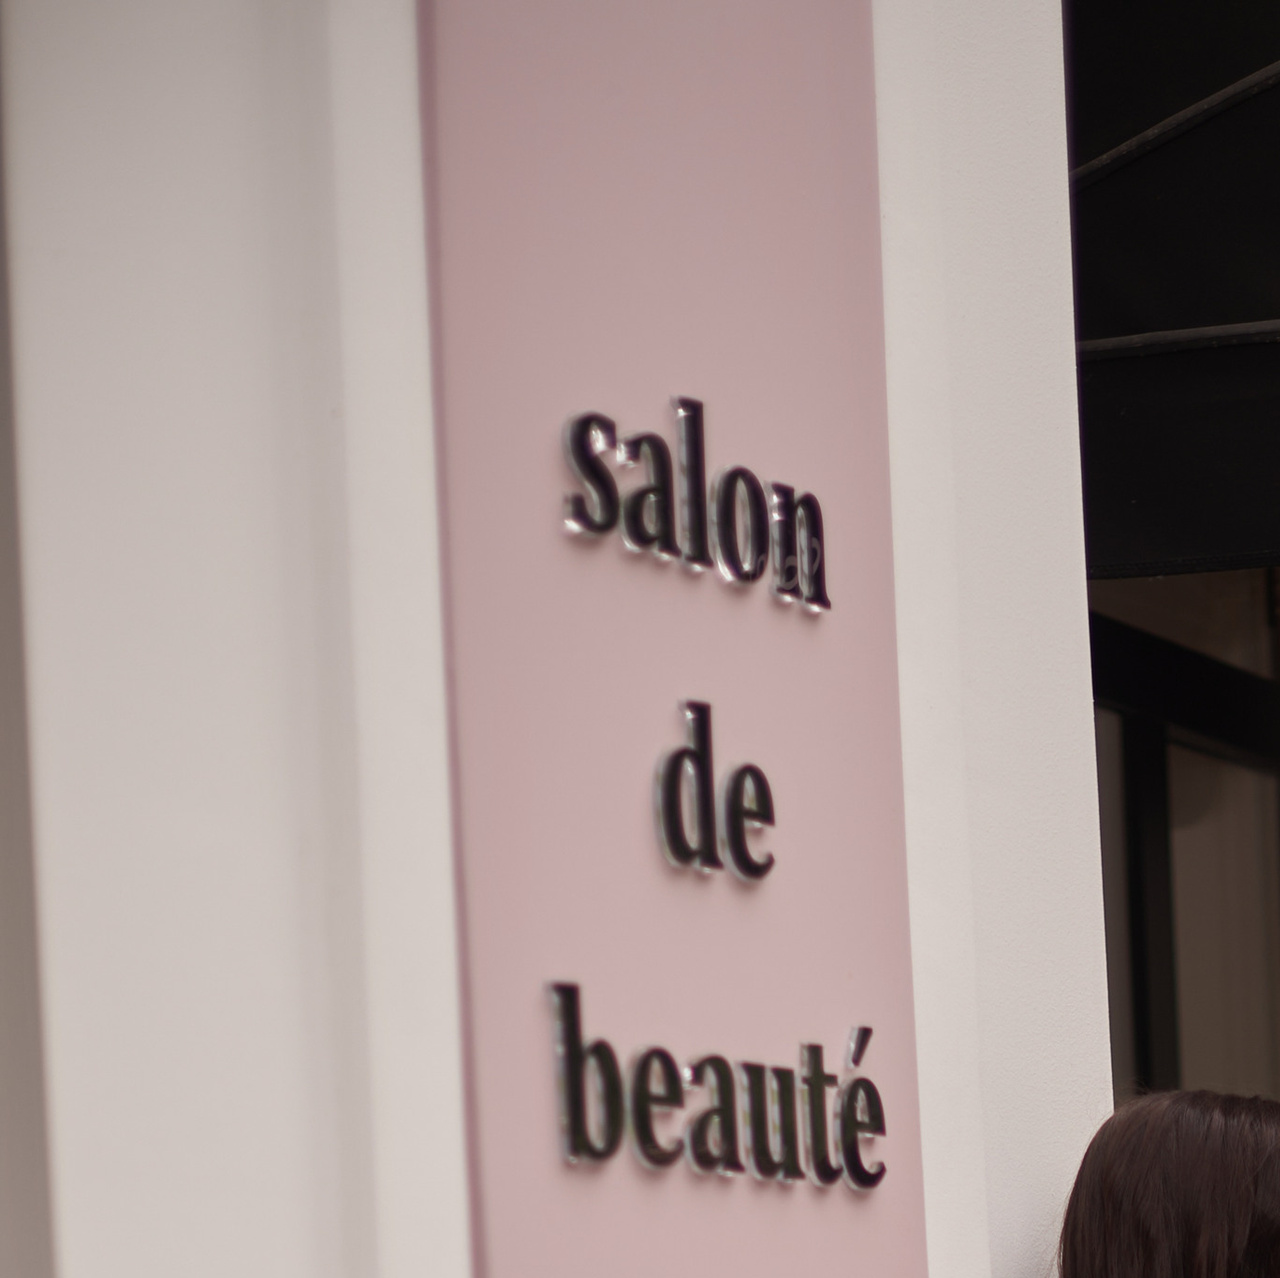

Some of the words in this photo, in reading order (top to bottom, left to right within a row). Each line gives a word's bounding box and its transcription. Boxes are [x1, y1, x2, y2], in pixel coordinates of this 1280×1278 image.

[562, 396, 832, 612] salon
[657, 700, 776, 883] de
[548, 981, 888, 1192] beauté
